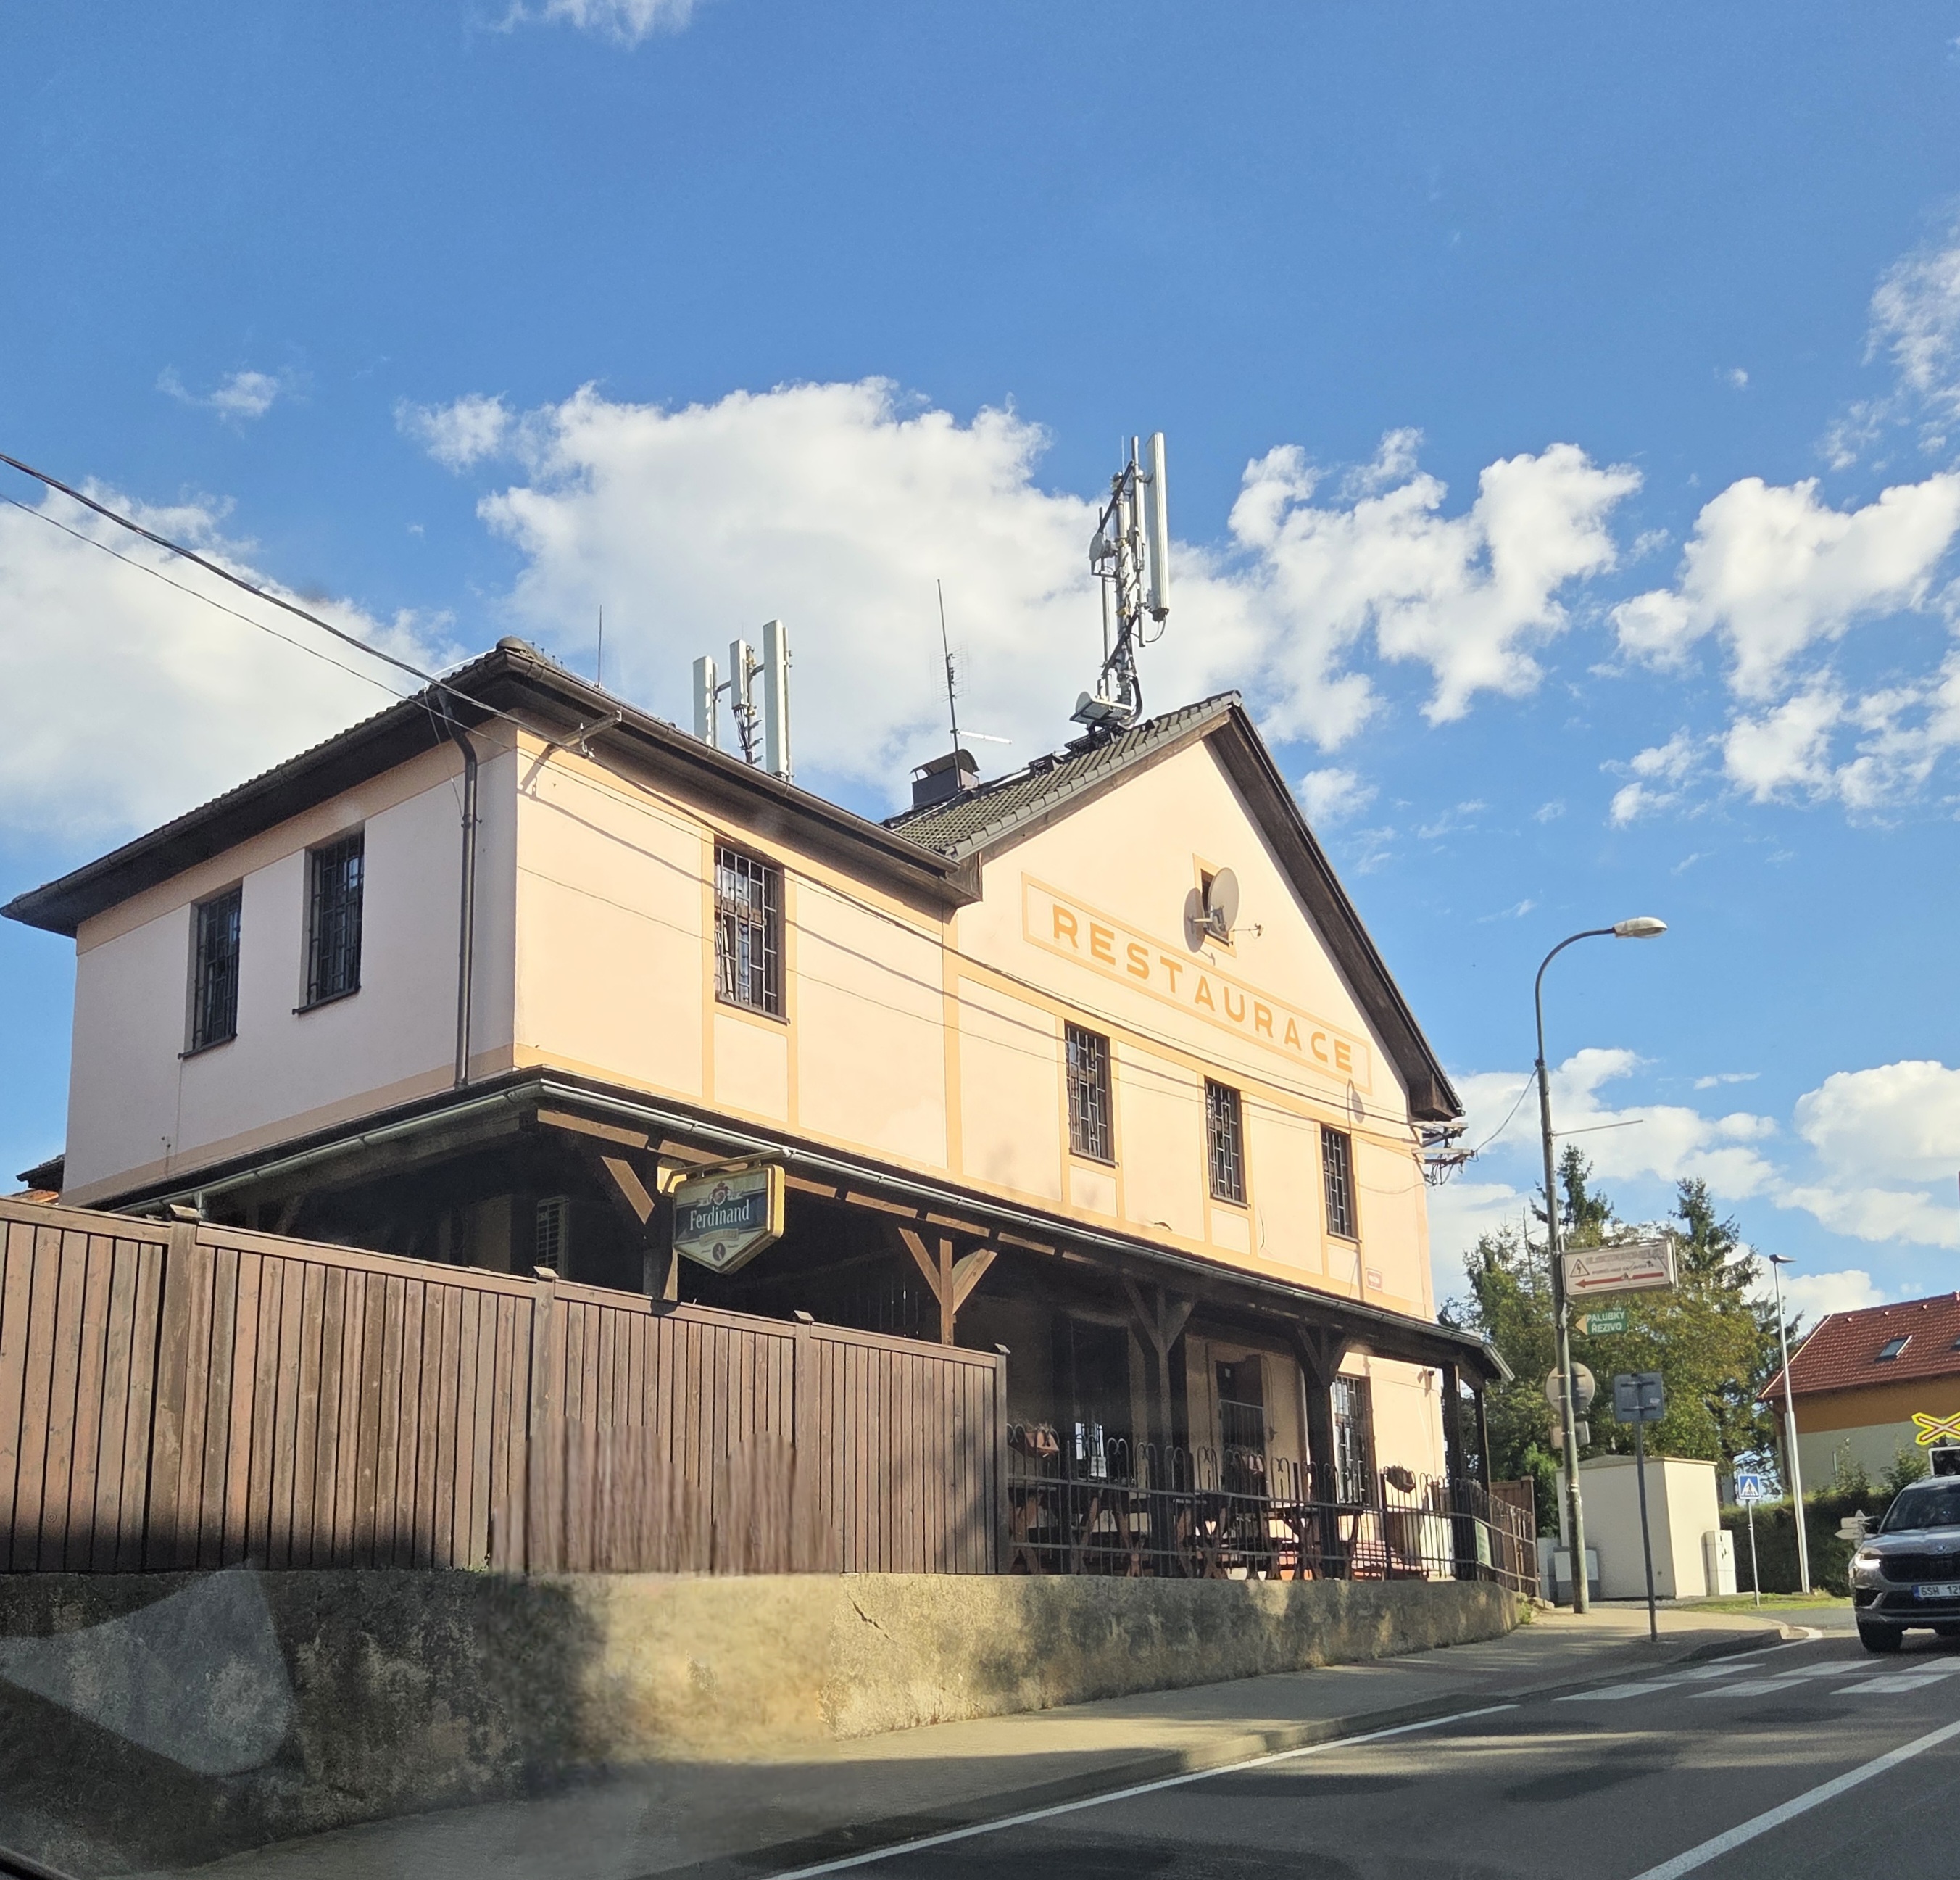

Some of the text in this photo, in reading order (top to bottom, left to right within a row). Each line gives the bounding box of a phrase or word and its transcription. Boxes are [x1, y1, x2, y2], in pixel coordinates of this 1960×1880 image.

[1052, 903, 1353, 1072] RESTAURACE
[689, 1198, 749, 1231] Ferdinand
[1586, 1310, 1625, 1323] PALUBKY
[1946, 1585, 1960, 1595] 12
